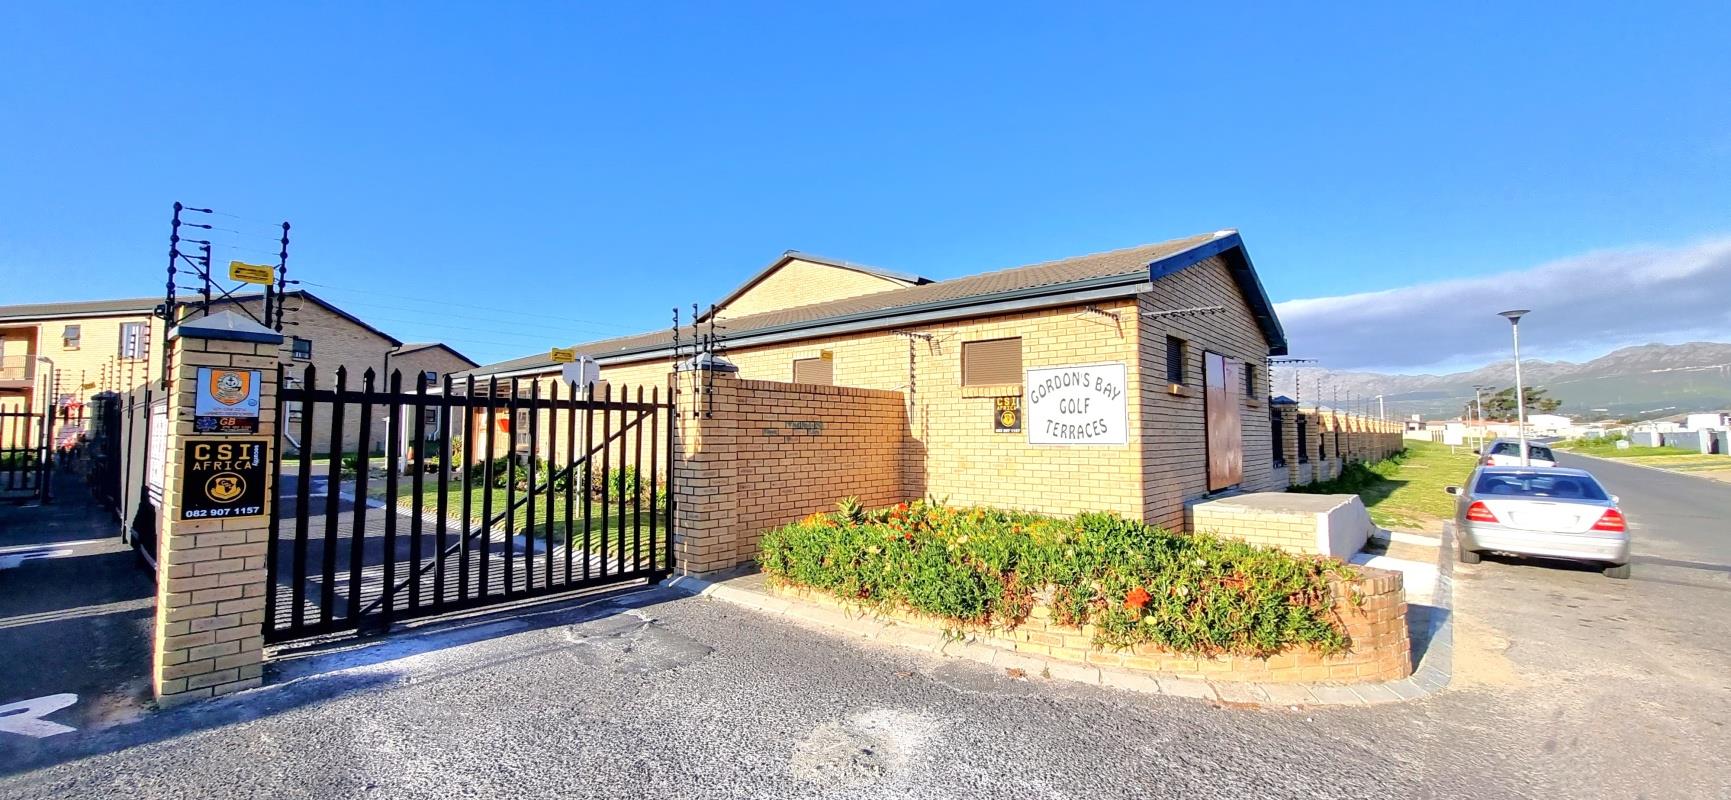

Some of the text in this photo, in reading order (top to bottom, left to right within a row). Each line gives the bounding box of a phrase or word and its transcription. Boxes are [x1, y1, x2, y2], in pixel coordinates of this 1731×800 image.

[1031, 372, 1090, 404] GORDON'S
[1095, 377, 1121, 400] BAY
[996, 397, 1016, 406] CSI
[1060, 398, 1090, 414] GOLF
[220, 417, 236, 426] GB
[1046, 418, 1108, 440] TERRACES
[194, 444, 252, 460] CSI
[193, 461, 252, 471] AFRICA
[185, 506, 260, 518] 082 907 1157
